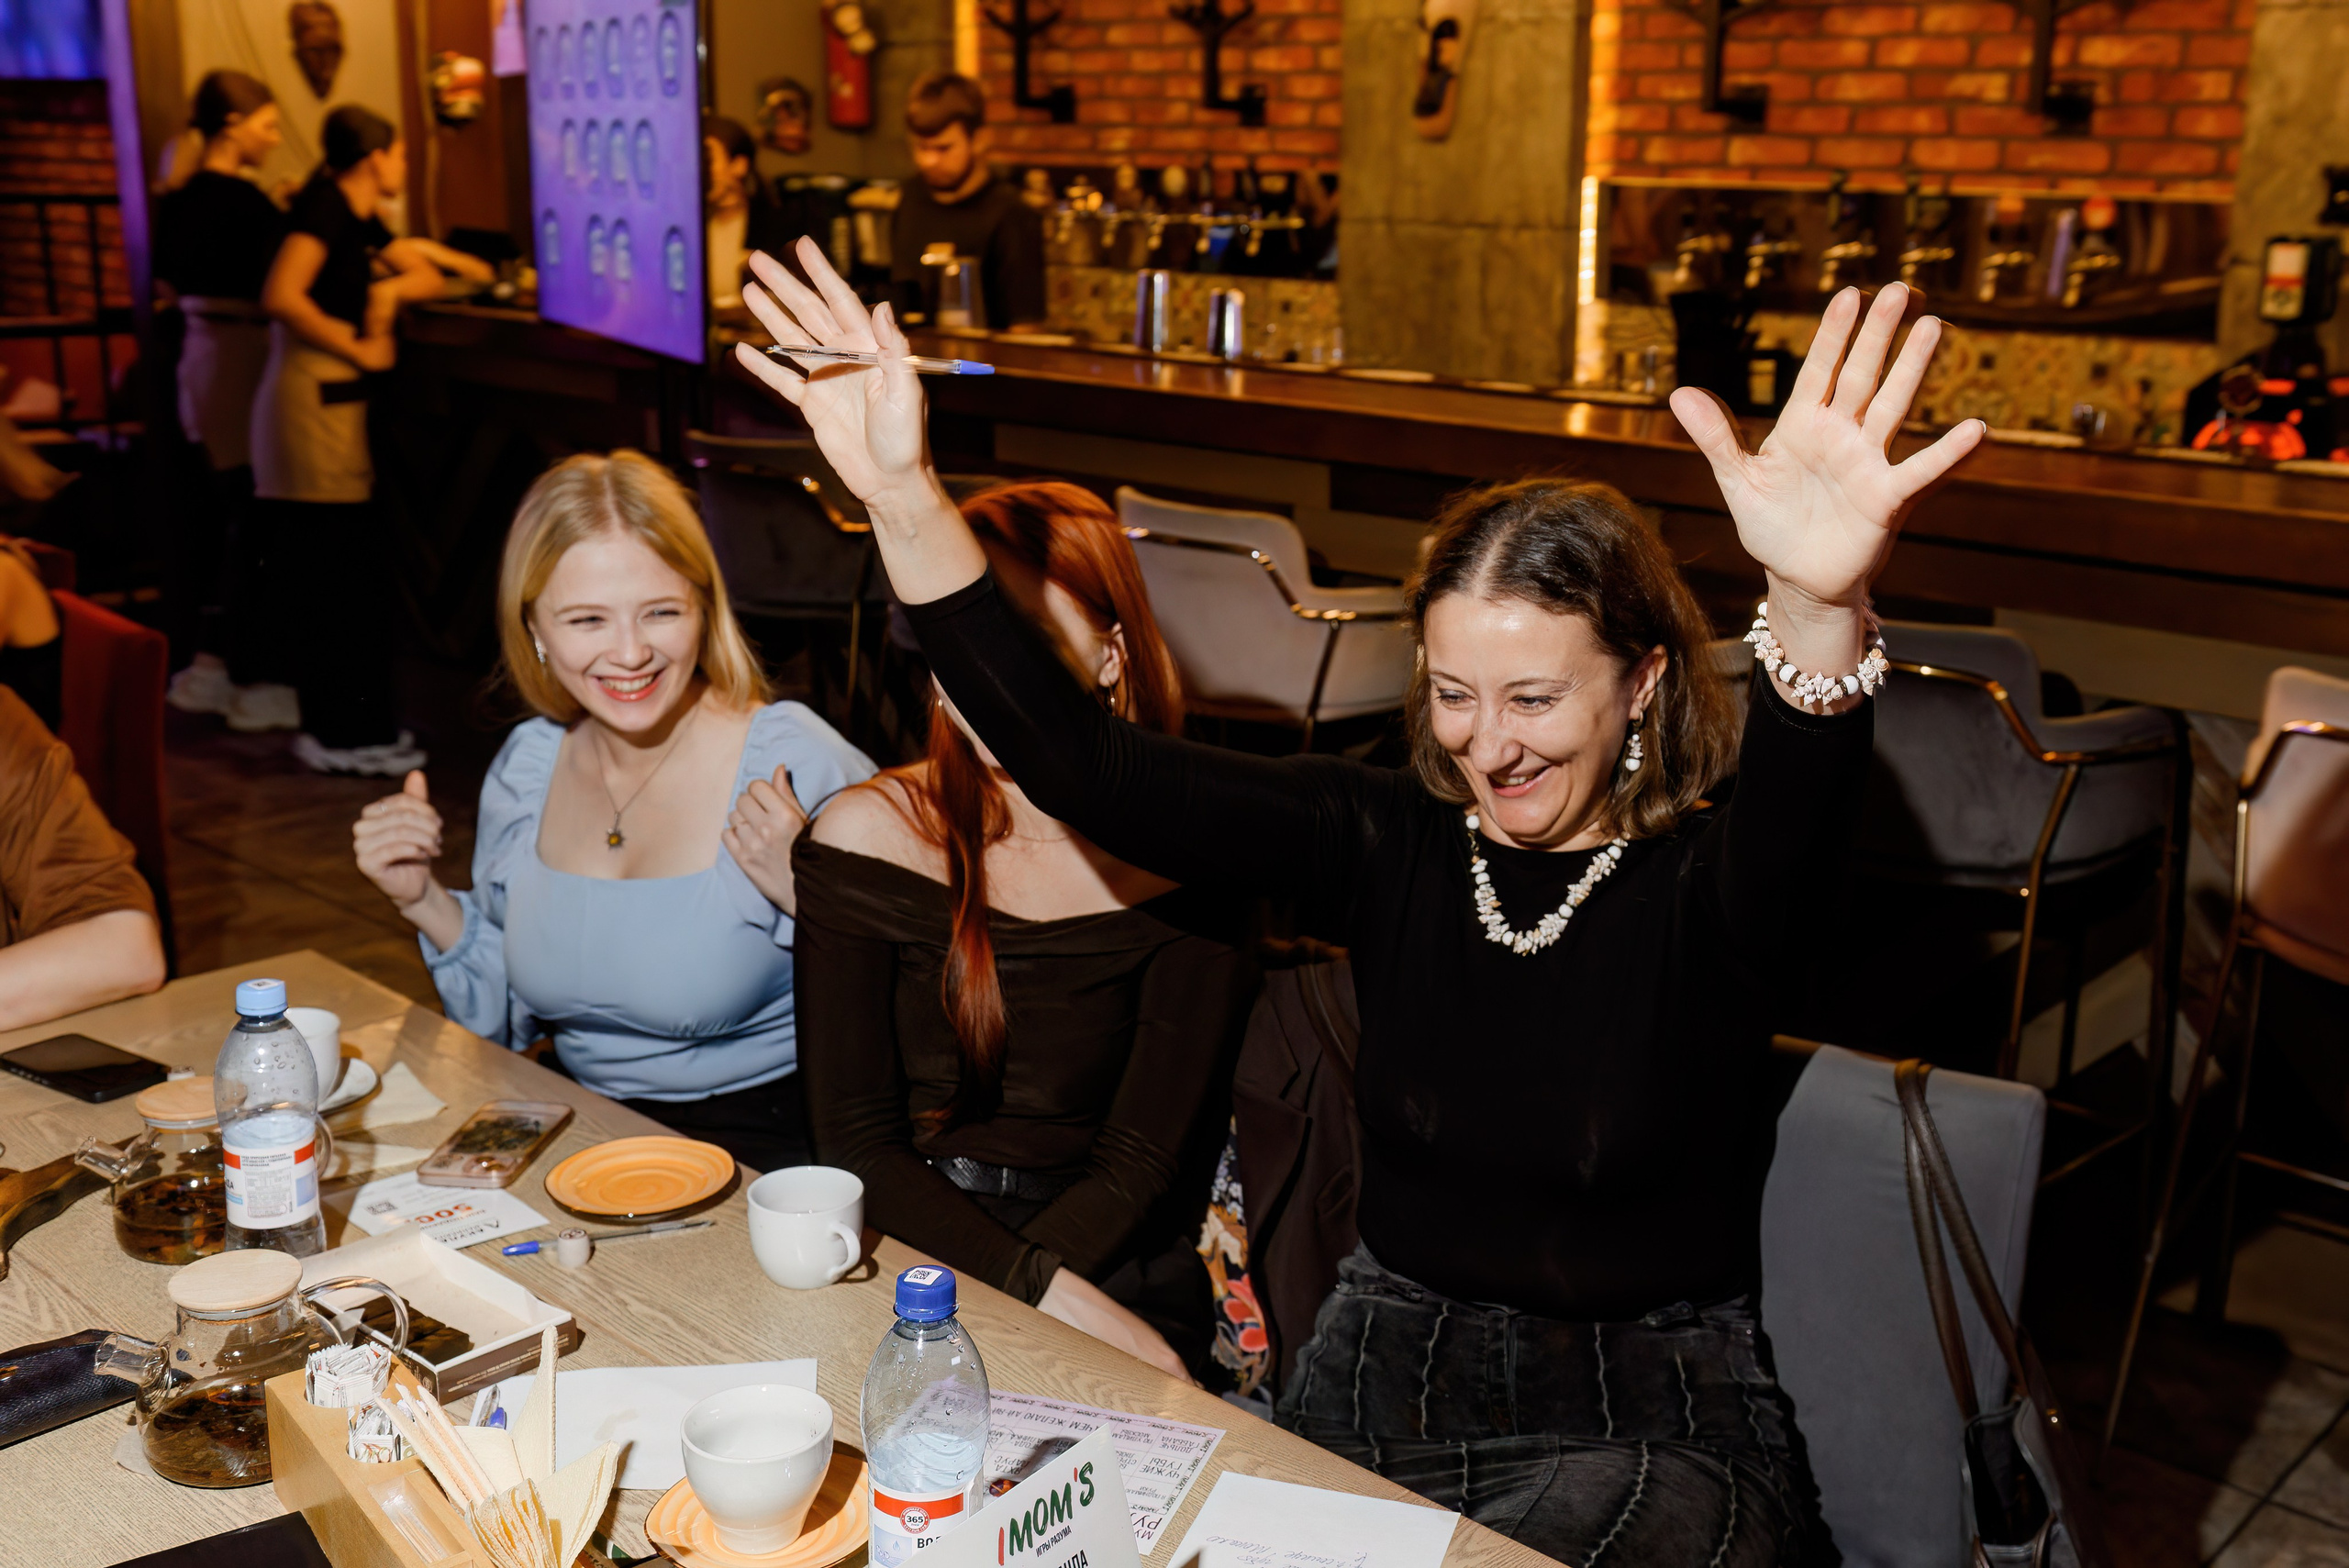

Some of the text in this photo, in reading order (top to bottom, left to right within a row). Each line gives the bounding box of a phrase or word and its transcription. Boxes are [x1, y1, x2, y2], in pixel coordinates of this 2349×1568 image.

[1023, 1413, 1066, 1427] ЖЕЛАЮ
[1159, 1442, 1193, 1454] ДОЛЬЧЕ
[1149, 1457, 1183, 1471] ГУБЫ
[1140, 1464, 1180, 1479] ЧУЖИЕ
[917, 1535, 942, 1549] ВО
[1035, 1525, 1073, 1558] ИГРЫ РАЗУМА
